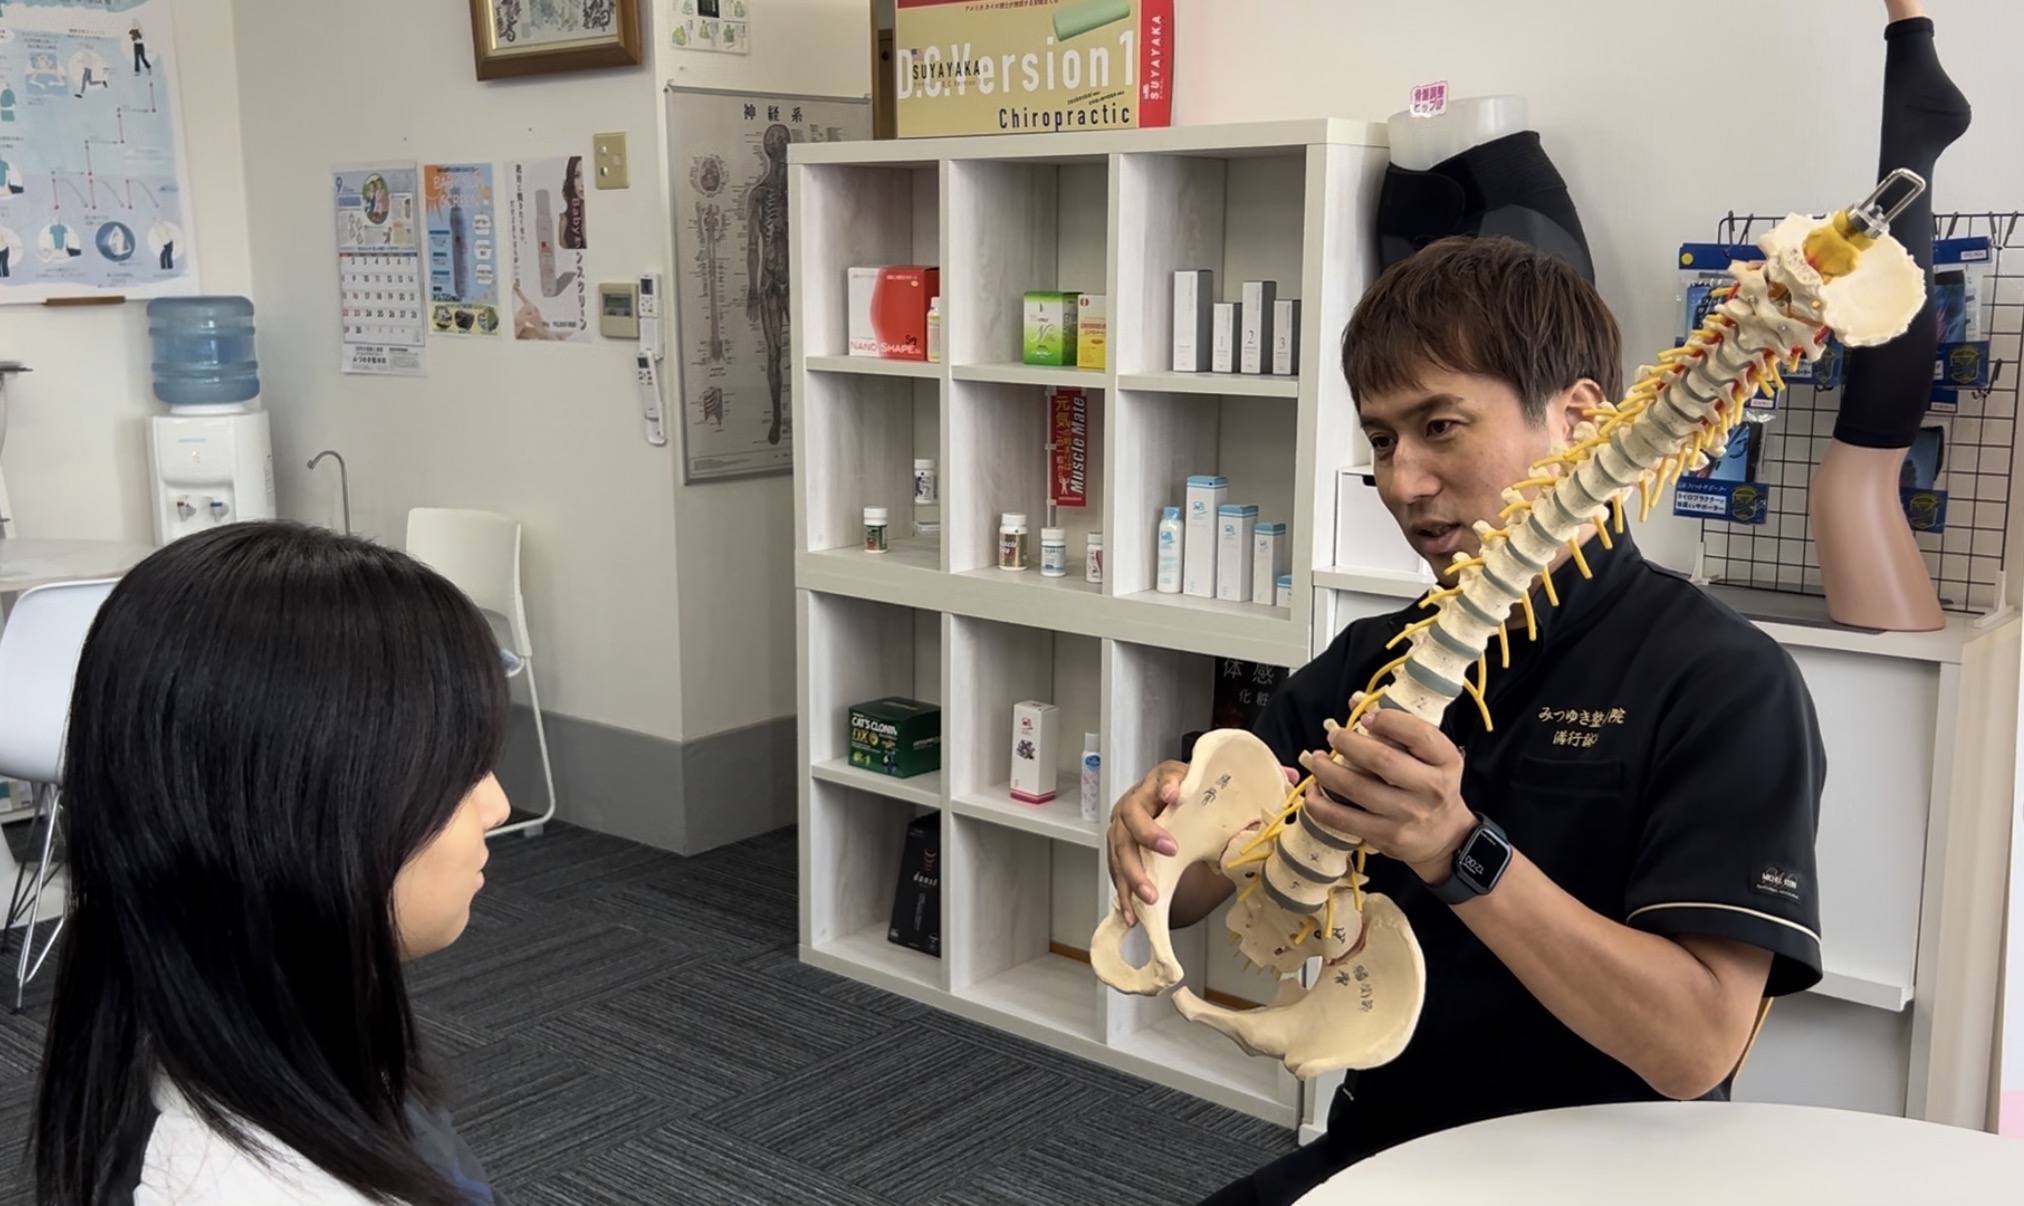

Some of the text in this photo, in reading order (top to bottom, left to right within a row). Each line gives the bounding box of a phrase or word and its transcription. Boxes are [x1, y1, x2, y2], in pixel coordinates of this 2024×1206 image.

[1150, 15, 1162, 100] SUYAYAKA
[912, 60, 981, 80] SUYAYAKA
[744, 104, 803, 123] 神経系
[999, 102, 1130, 132] Chiropractic
[336, 176, 343, 192] 9
[1247, 329, 1255, 344] 2
[1279, 337, 1286, 350] 3
[880, 342, 916, 354] SHAPE
[1070, 397, 1085, 494] Muscle Mate
